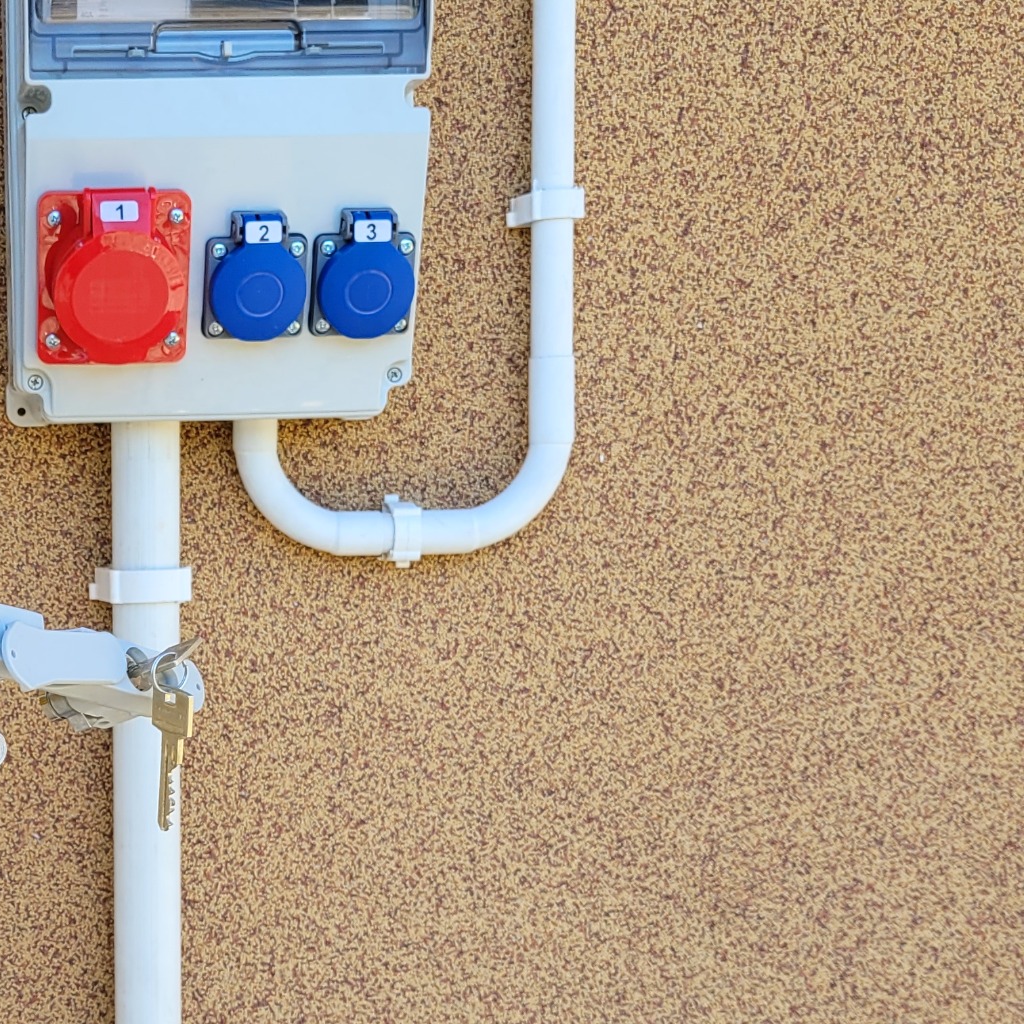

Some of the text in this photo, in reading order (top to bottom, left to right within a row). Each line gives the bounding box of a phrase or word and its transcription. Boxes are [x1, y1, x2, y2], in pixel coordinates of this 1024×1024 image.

[115, 204, 124, 220] 1
[259, 225, 270, 242] 2
[366, 223, 376, 240] 3
